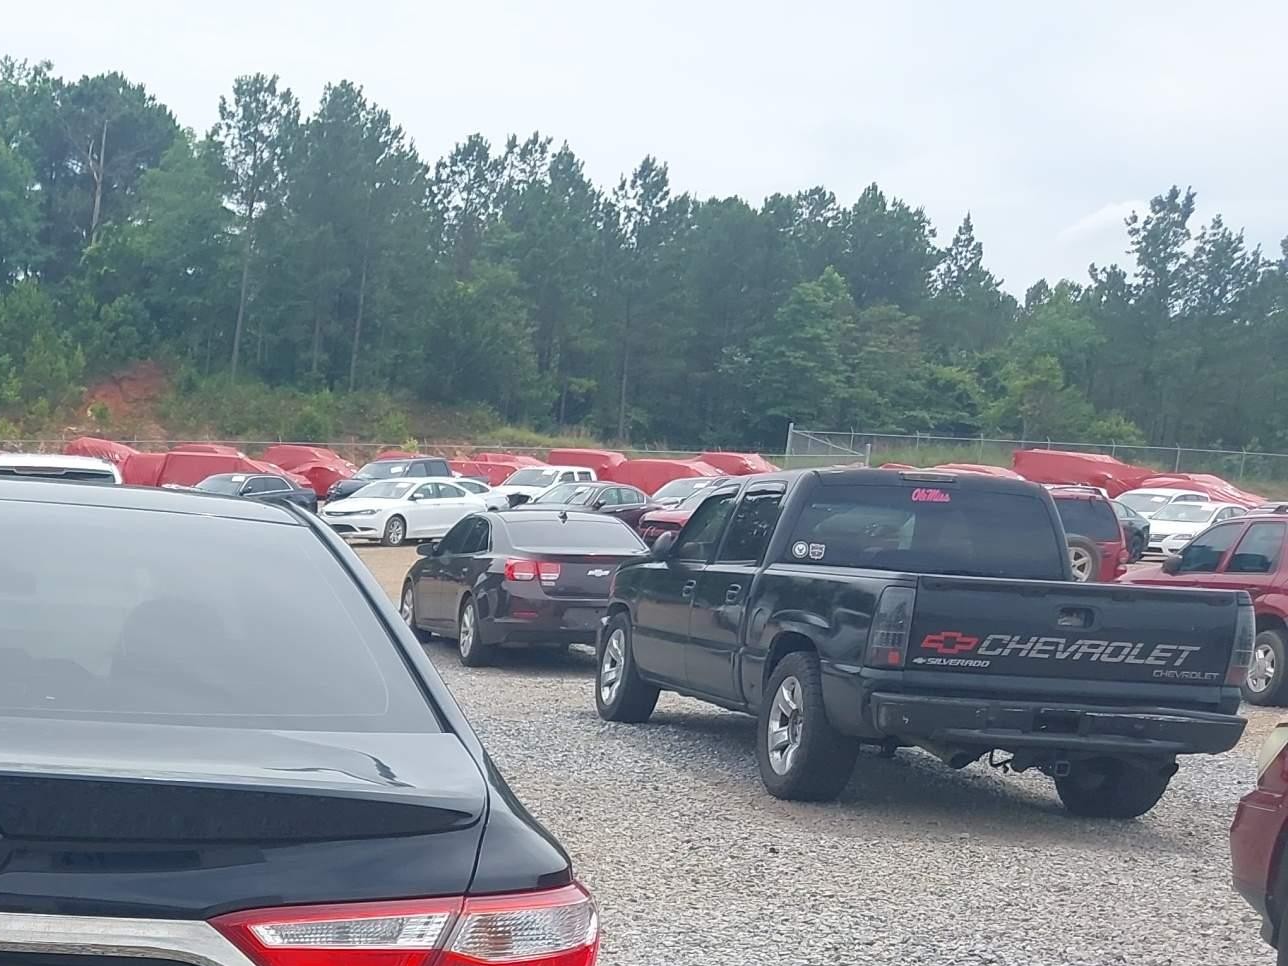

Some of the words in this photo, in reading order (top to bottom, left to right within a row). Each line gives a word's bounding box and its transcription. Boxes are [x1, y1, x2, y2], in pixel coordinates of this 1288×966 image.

[977, 634, 1200, 666] CHEVROLET
[925, 657, 991, 668] SILVERADO
[1152, 669, 1220, 680] CHEVROLET
